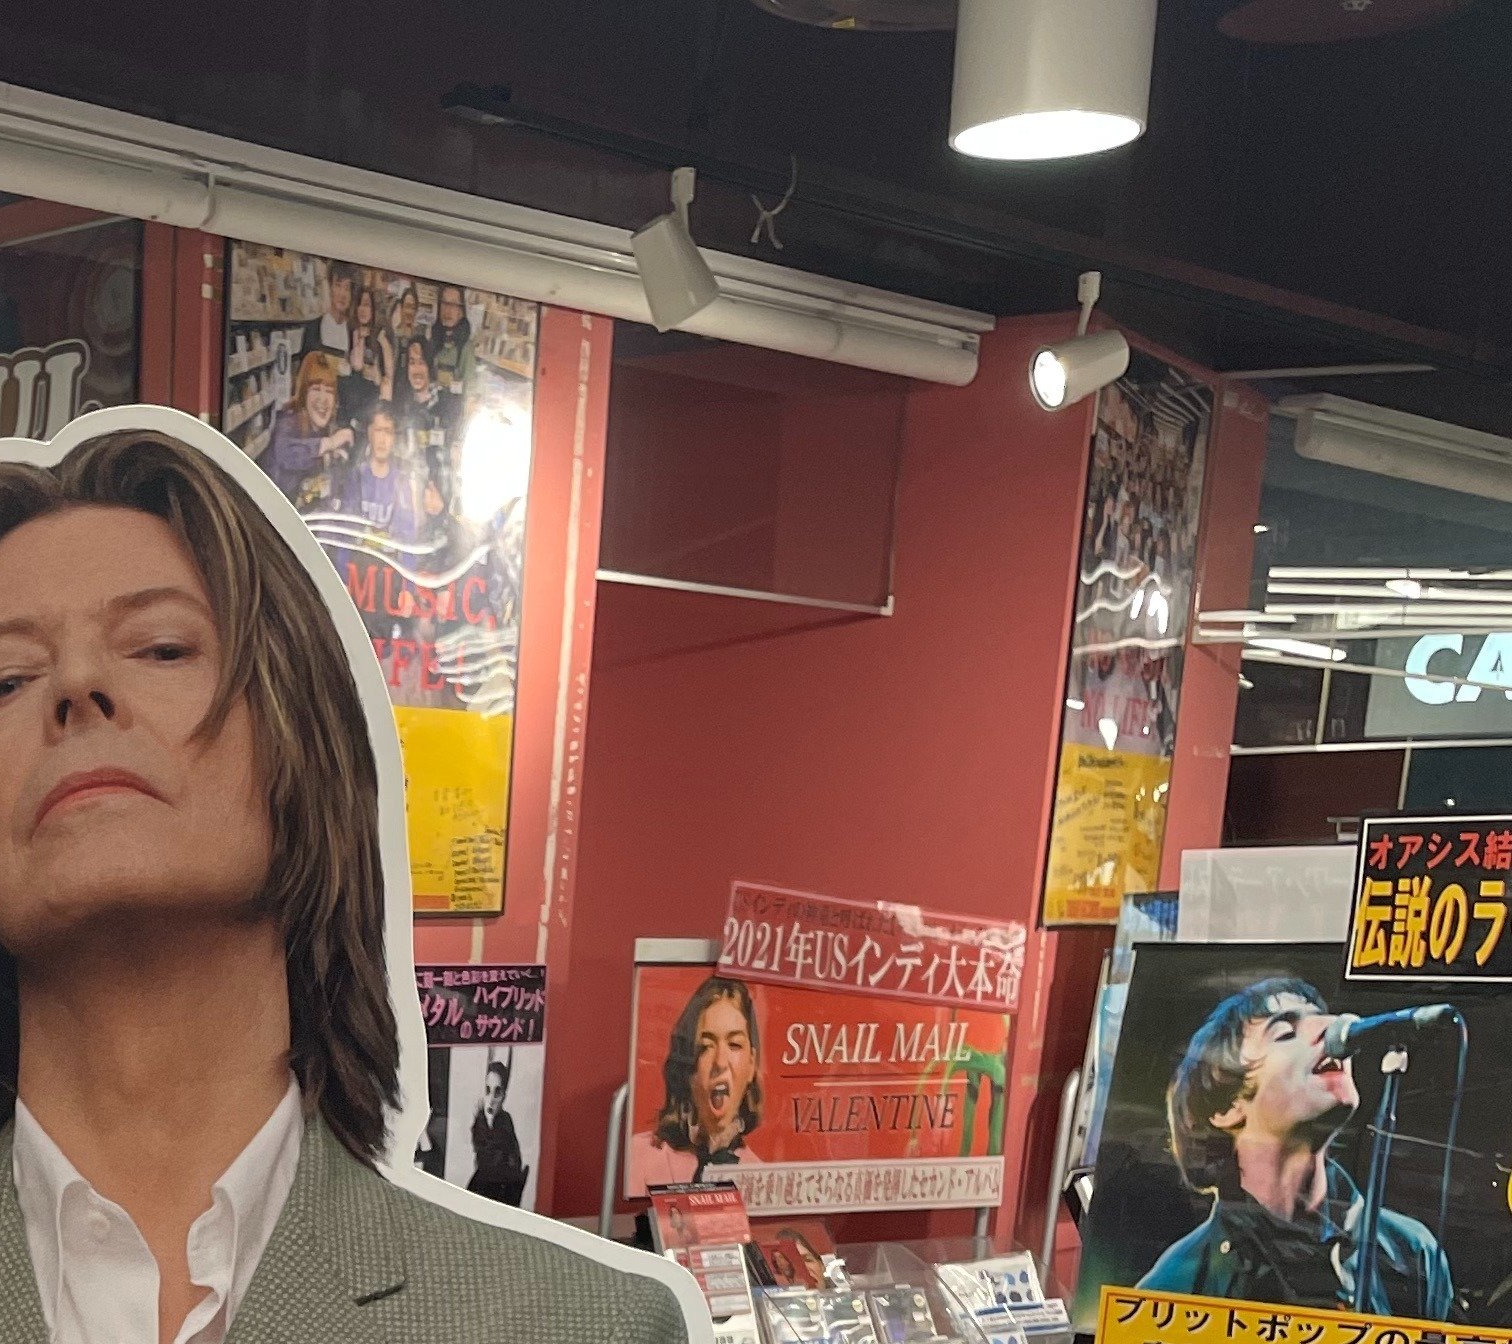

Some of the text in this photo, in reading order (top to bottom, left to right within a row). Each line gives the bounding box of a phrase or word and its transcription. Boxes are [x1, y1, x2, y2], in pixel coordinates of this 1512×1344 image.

[782, 1022, 972, 1066] SNAIL MAIL
[790, 1092, 959, 1134] VALENTINE
